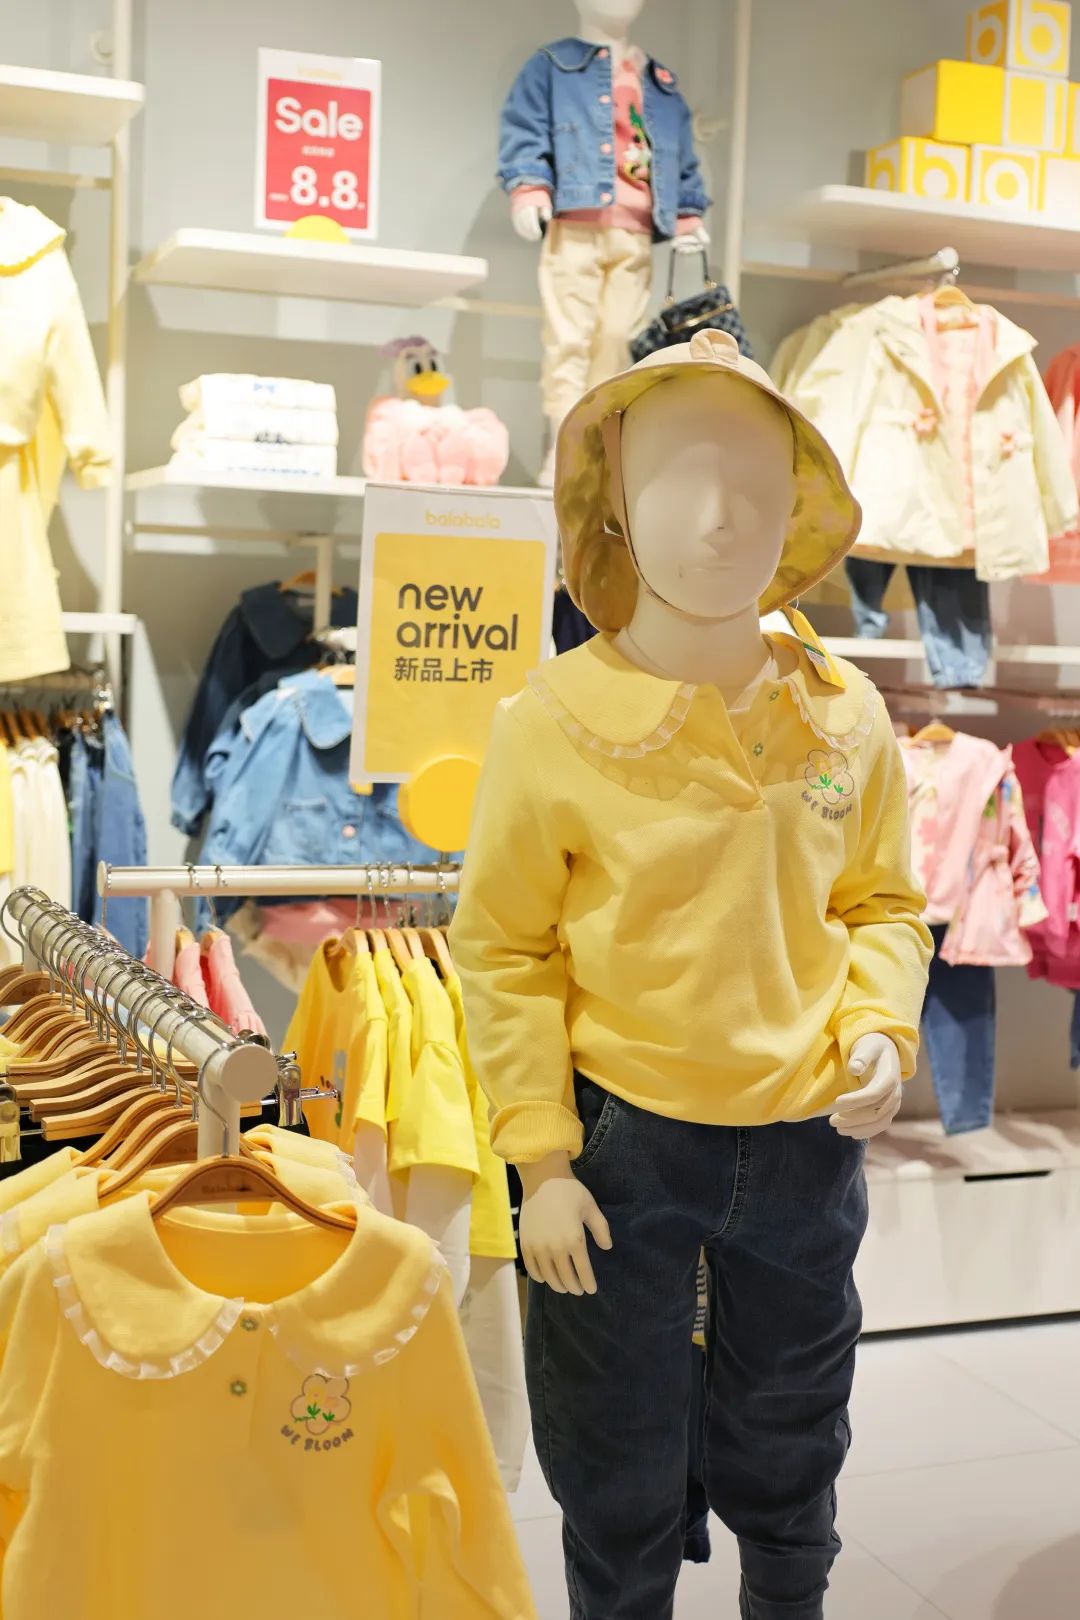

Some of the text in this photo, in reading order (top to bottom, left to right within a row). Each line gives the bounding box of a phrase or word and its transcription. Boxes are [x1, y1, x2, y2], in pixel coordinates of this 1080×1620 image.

[274, 96, 363, 141] Sale
[290, 165, 358, 210] 8.8
[398, 583, 483, 612] new
[396, 613, 519, 651] arrival
[394, 656, 494, 683] 新品上市
[821, 803, 853, 821] BLOOM
[281, 1424, 354, 1452] WE BLOOM
